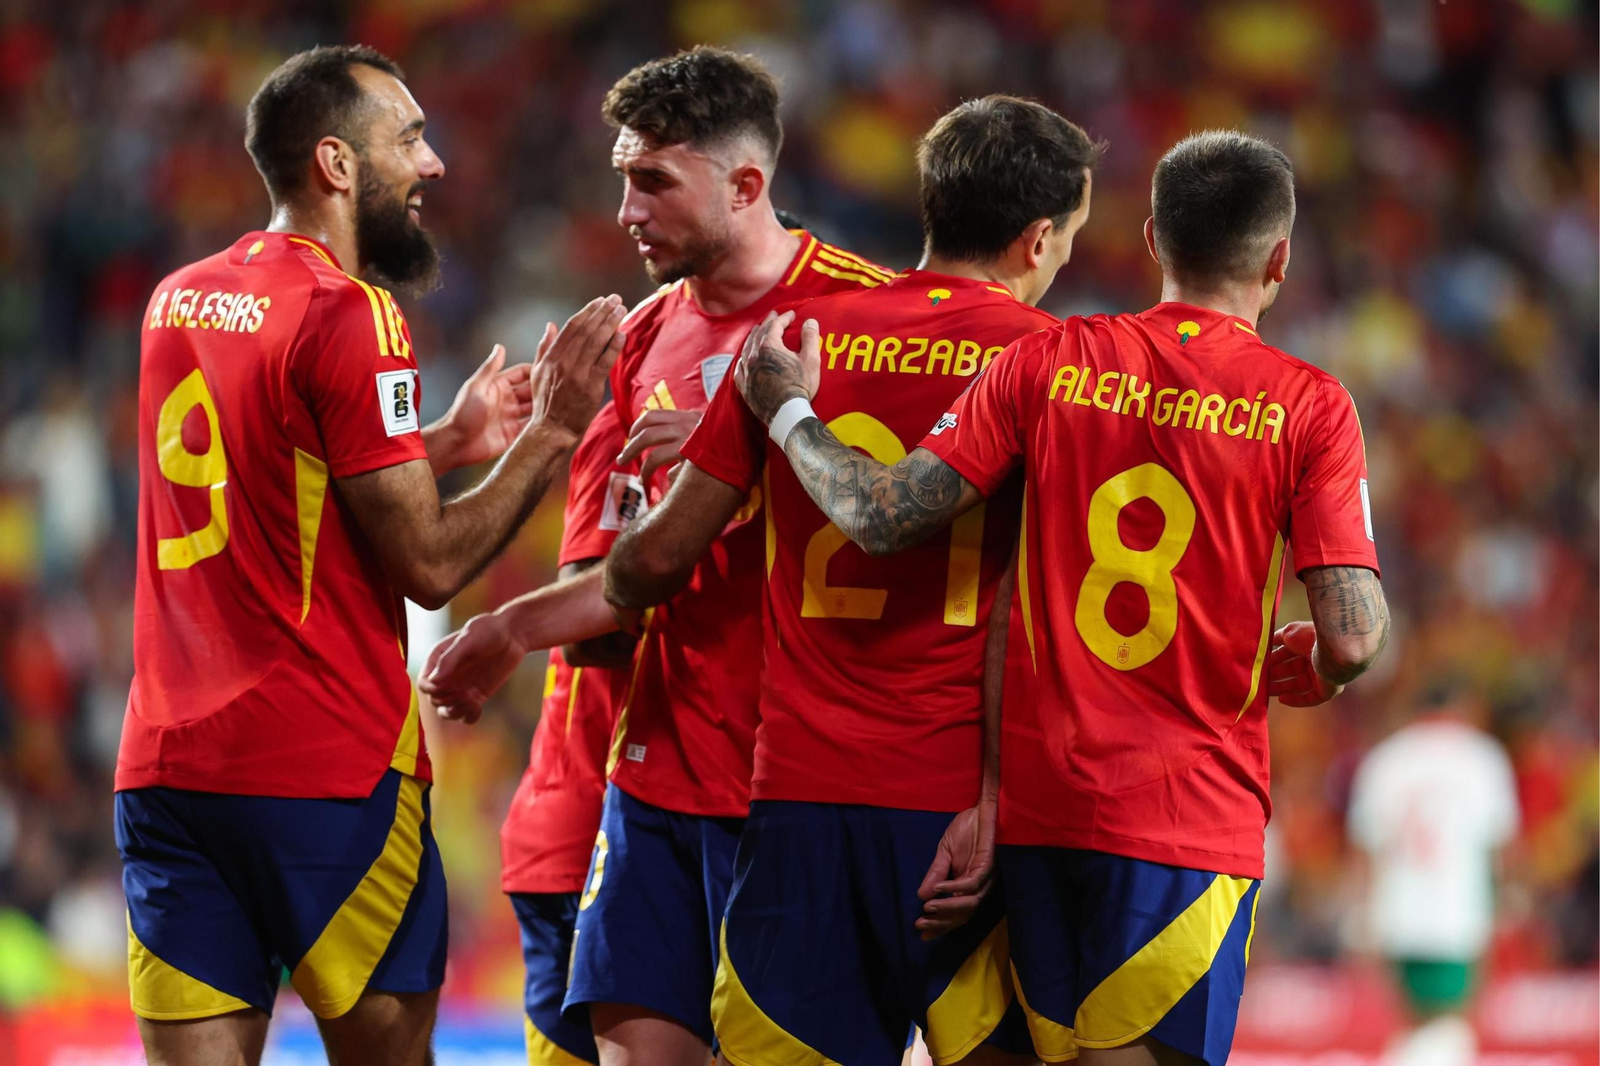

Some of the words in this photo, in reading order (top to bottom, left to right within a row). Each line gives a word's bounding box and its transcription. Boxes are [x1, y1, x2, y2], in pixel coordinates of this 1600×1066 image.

[148, 290, 168, 331] B.
[166, 287, 272, 334] IGLESIAS
[156, 368, 229, 571] 9
[1049, 364, 1152, 419] ALEIX
[1151, 390, 1286, 445] GARCÍA
[1075, 462, 1197, 671] 8
